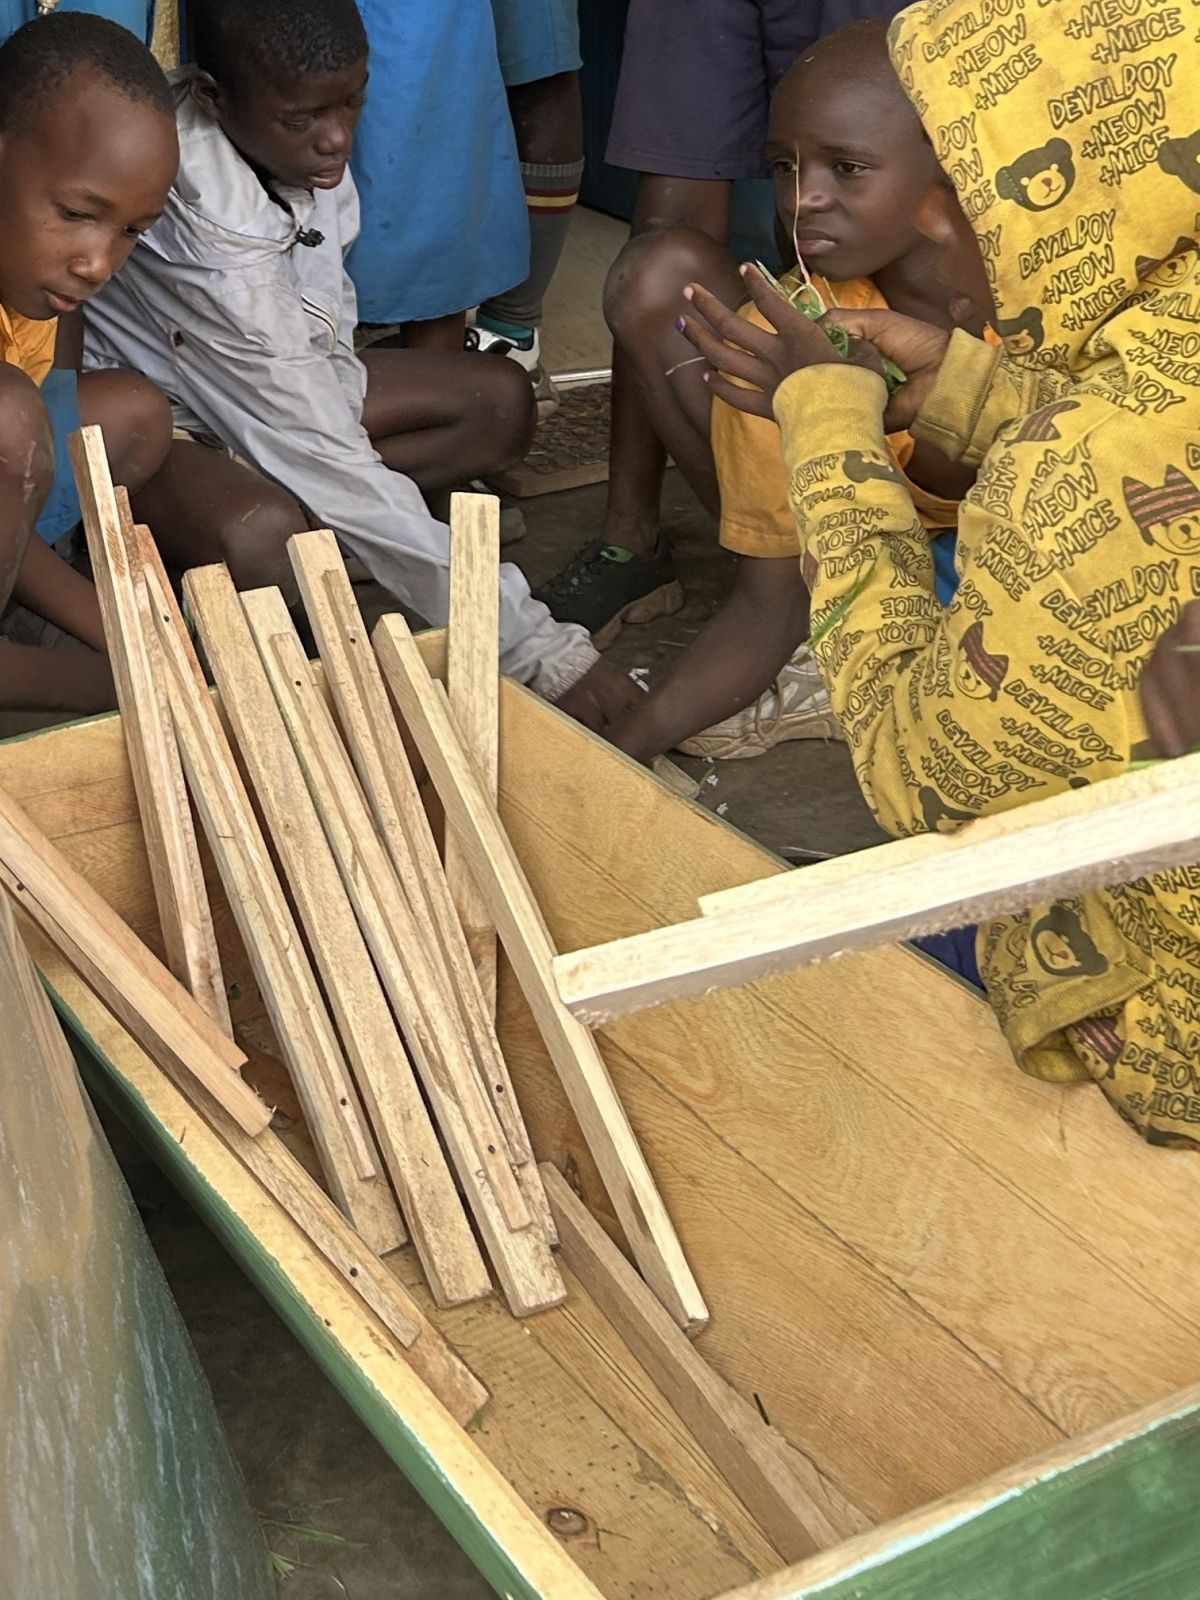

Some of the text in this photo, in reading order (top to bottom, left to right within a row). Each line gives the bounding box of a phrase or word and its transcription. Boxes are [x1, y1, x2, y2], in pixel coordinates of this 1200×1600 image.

[949, 13, 1027, 88] +MEOW
[1091, 8, 1185, 65] +MICE
[975, 44, 1043, 111] +MICE
[1048, 53, 1177, 129] DEVILBOY
[1081, 88, 1166, 160] +MEOW
[1018, 208, 1116, 280] DEVILBOY
[1042, 244, 1116, 305] +MEOW
[1003, 679, 1124, 761] DEVILBOY
[1030, 664, 1115, 711] +MICE
[928, 736, 1011, 798] +MEOW
[936, 709, 1047, 792] DEVILBOY
[1000, 717, 1094, 768] +MEOW
